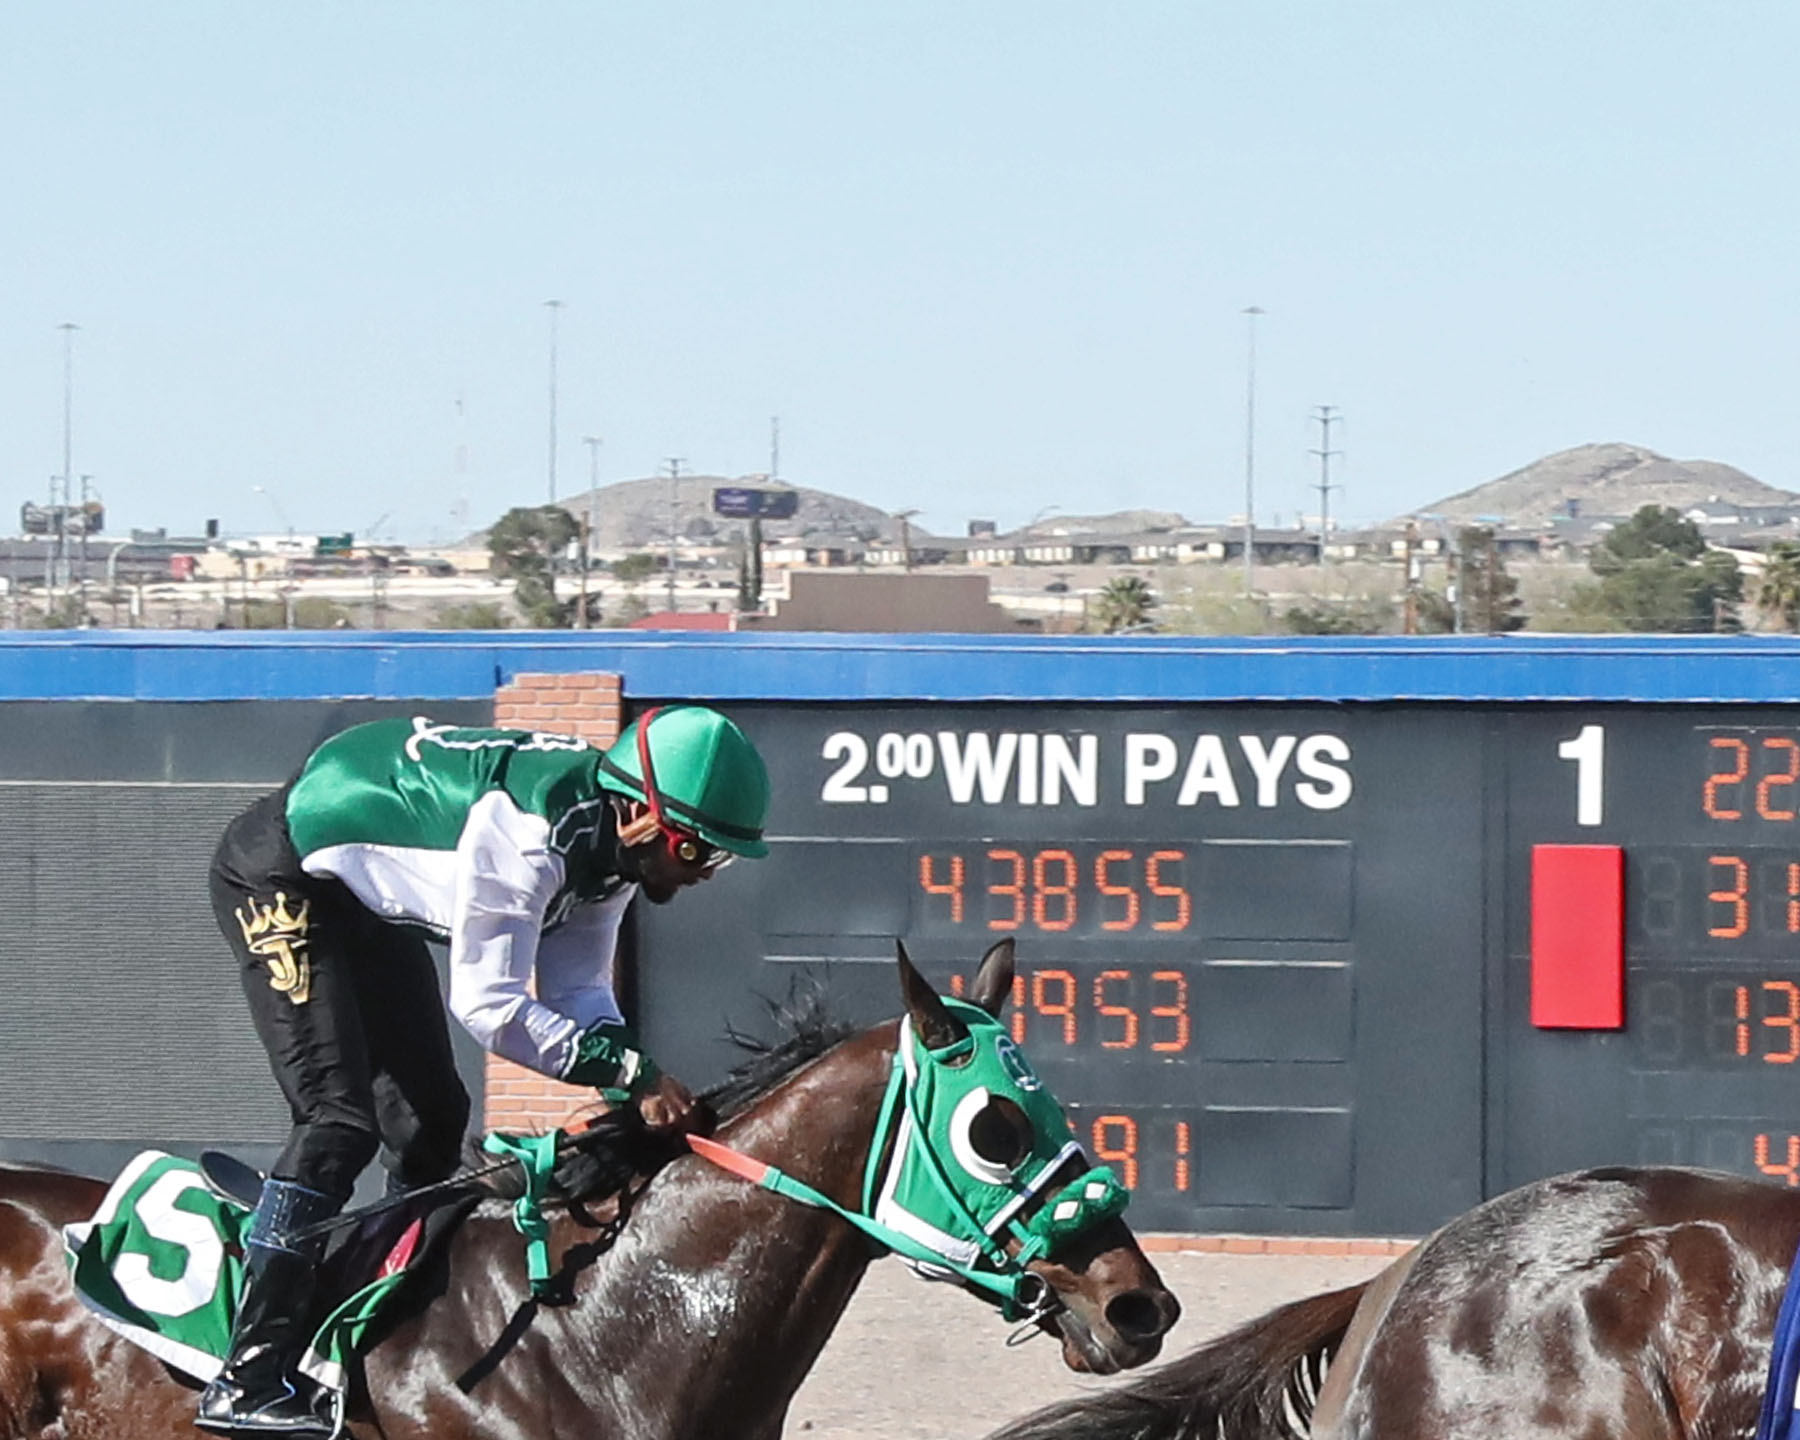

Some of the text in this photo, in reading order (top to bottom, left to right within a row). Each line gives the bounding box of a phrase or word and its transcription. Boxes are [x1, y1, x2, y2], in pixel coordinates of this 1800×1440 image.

[937, 731, 1098, 806] WIN
[1125, 733, 1353, 810] PAYS
[1559, 725, 1605, 826] 1
